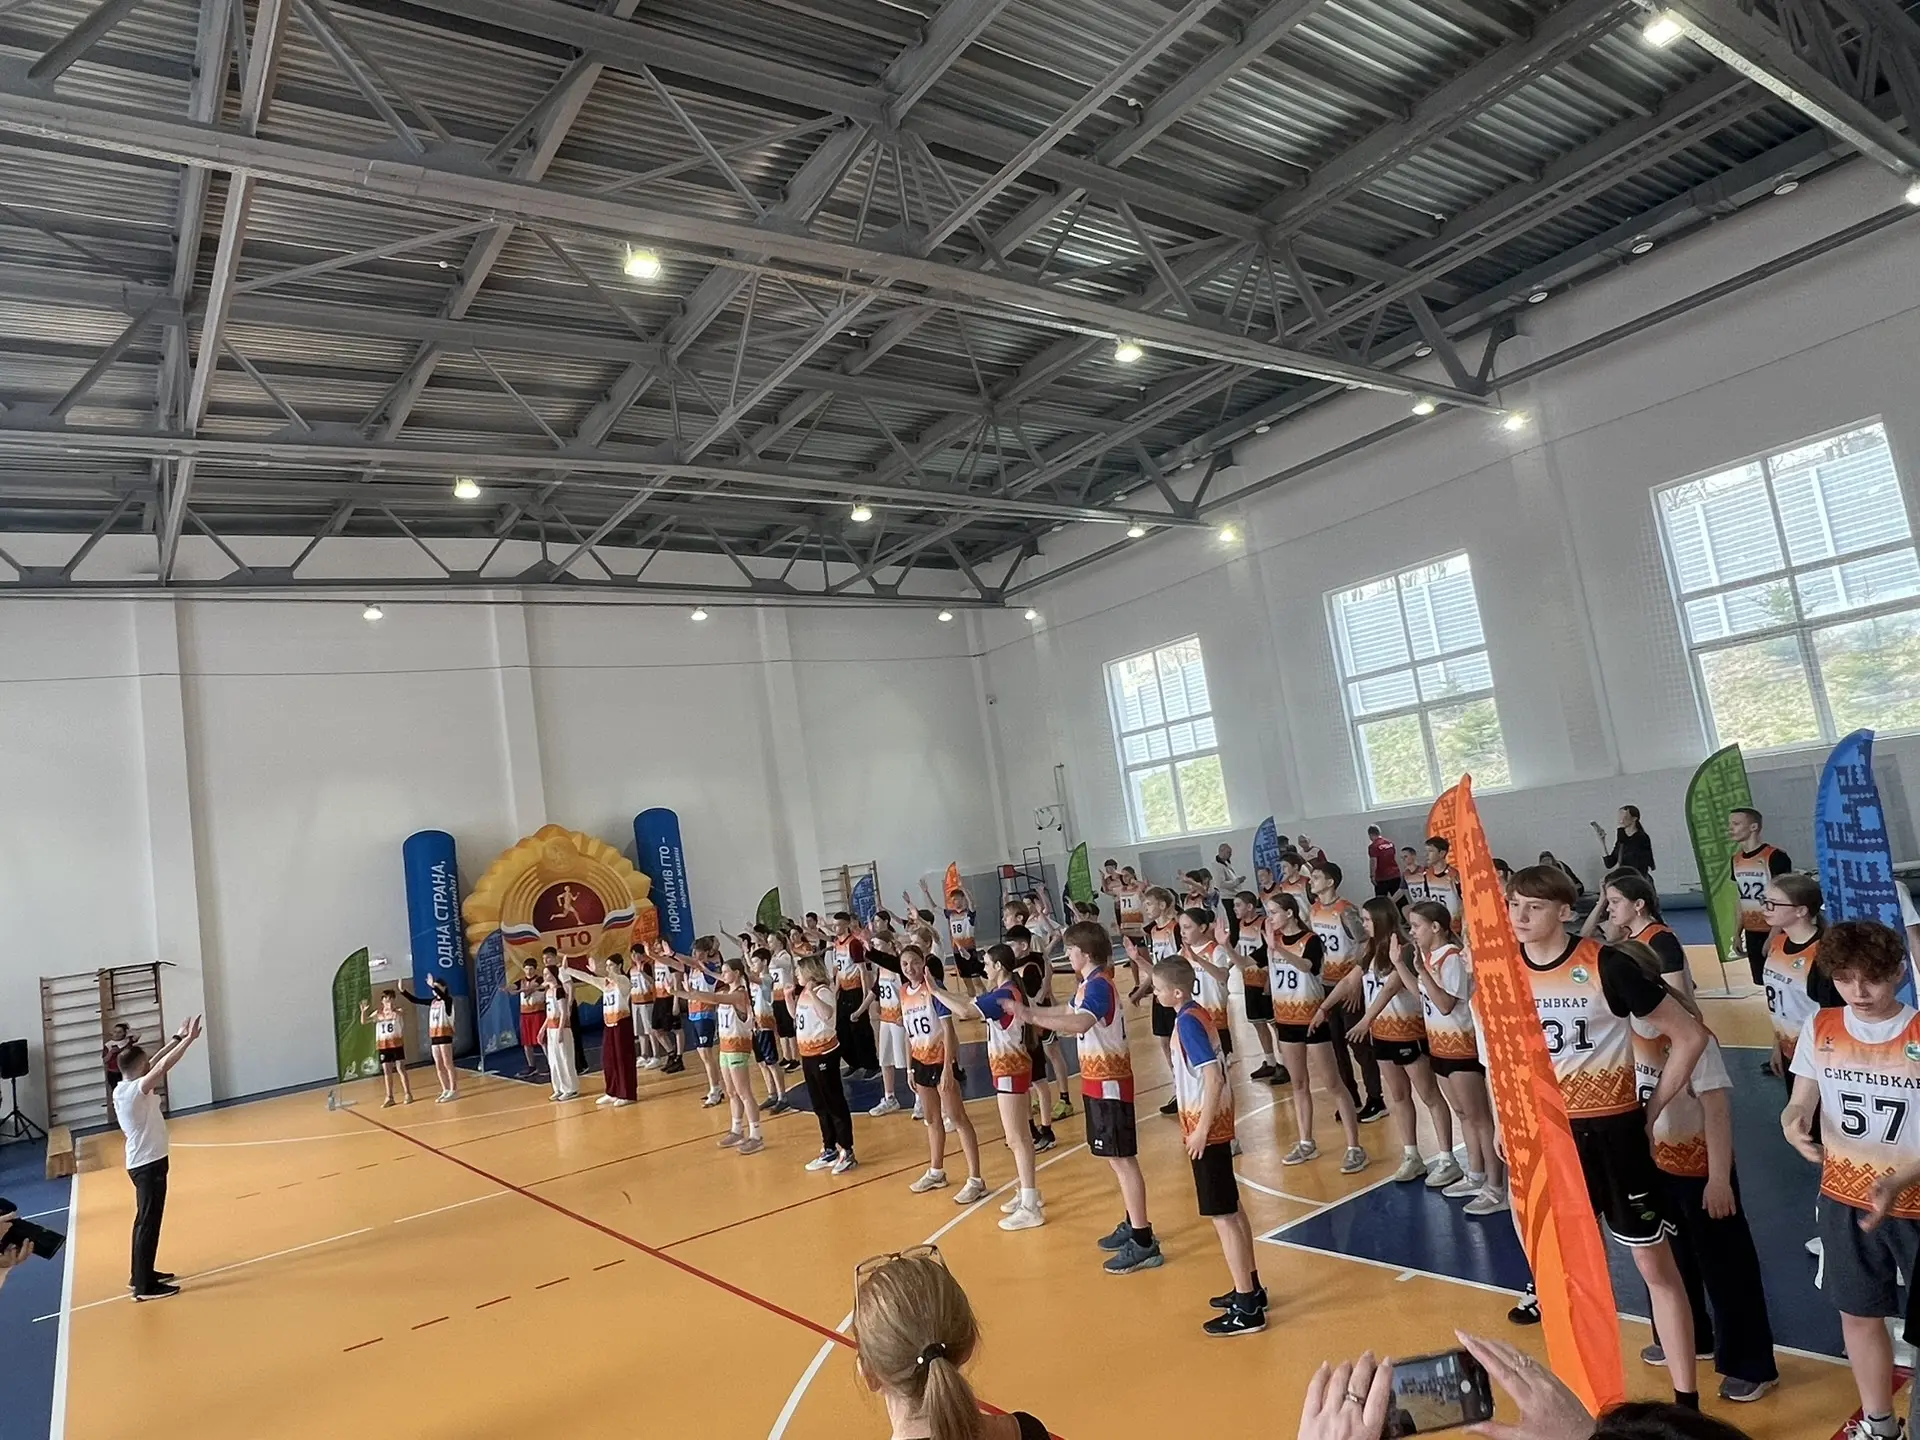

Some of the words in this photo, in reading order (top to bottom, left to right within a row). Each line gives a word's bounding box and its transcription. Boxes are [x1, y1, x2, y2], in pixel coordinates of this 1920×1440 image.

[658, 846, 672, 867] ГТО
[430, 860, 450, 921] СТРАНА,
[661, 869, 681, 933] НОРМАТИВ
[436, 924, 454, 969] ОДНА
[454, 936, 464, 966] одна
[555, 931, 592, 949] ГТО
[1276, 969, 1298, 990] 78
[1542, 1018, 1595, 1055] 31
[1839, 1091, 1909, 1145] 57
